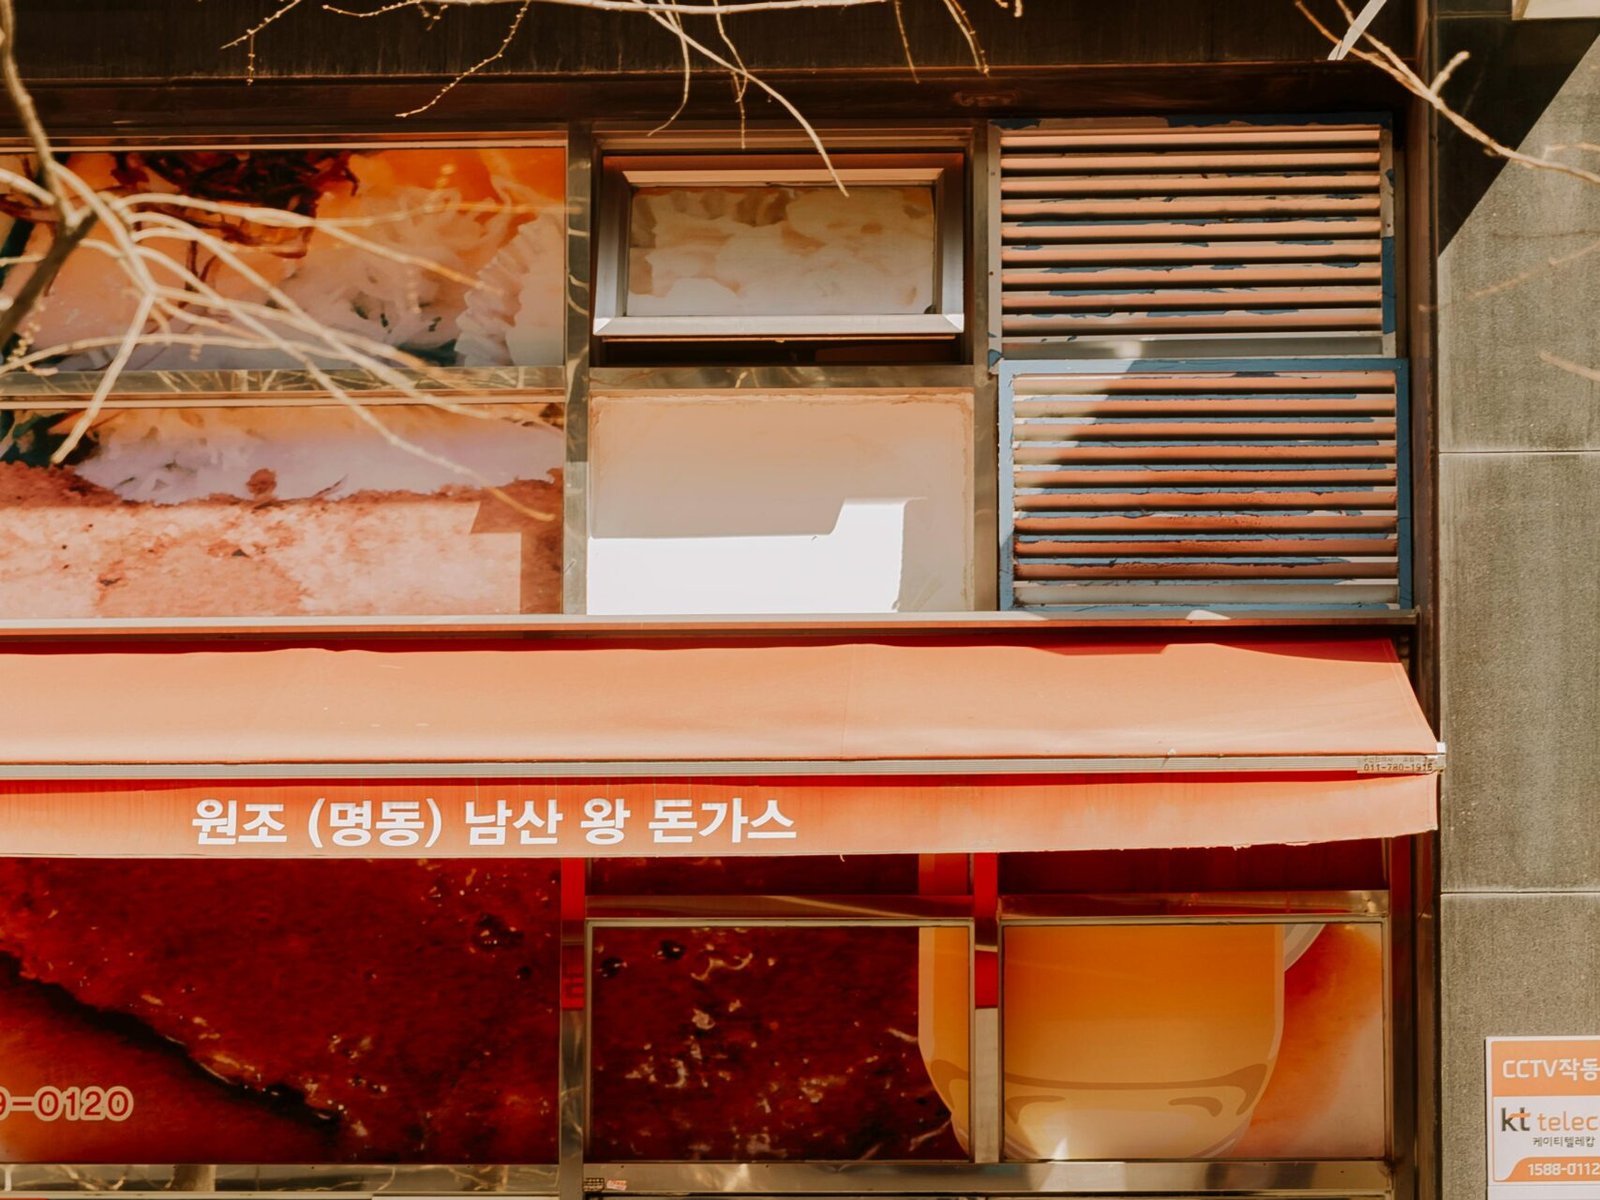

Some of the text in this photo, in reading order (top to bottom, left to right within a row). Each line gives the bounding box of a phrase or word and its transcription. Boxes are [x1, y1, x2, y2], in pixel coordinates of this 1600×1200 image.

[192, 797, 796, 848] 원조 (명동) 남산 왕 돈가스
[1501, 1107, 1531, 1132] kt
[1533, 1136, 1596, 1148] 케이티텔레캅
[1528, 1163, 1600, 1176] 1588-0112
